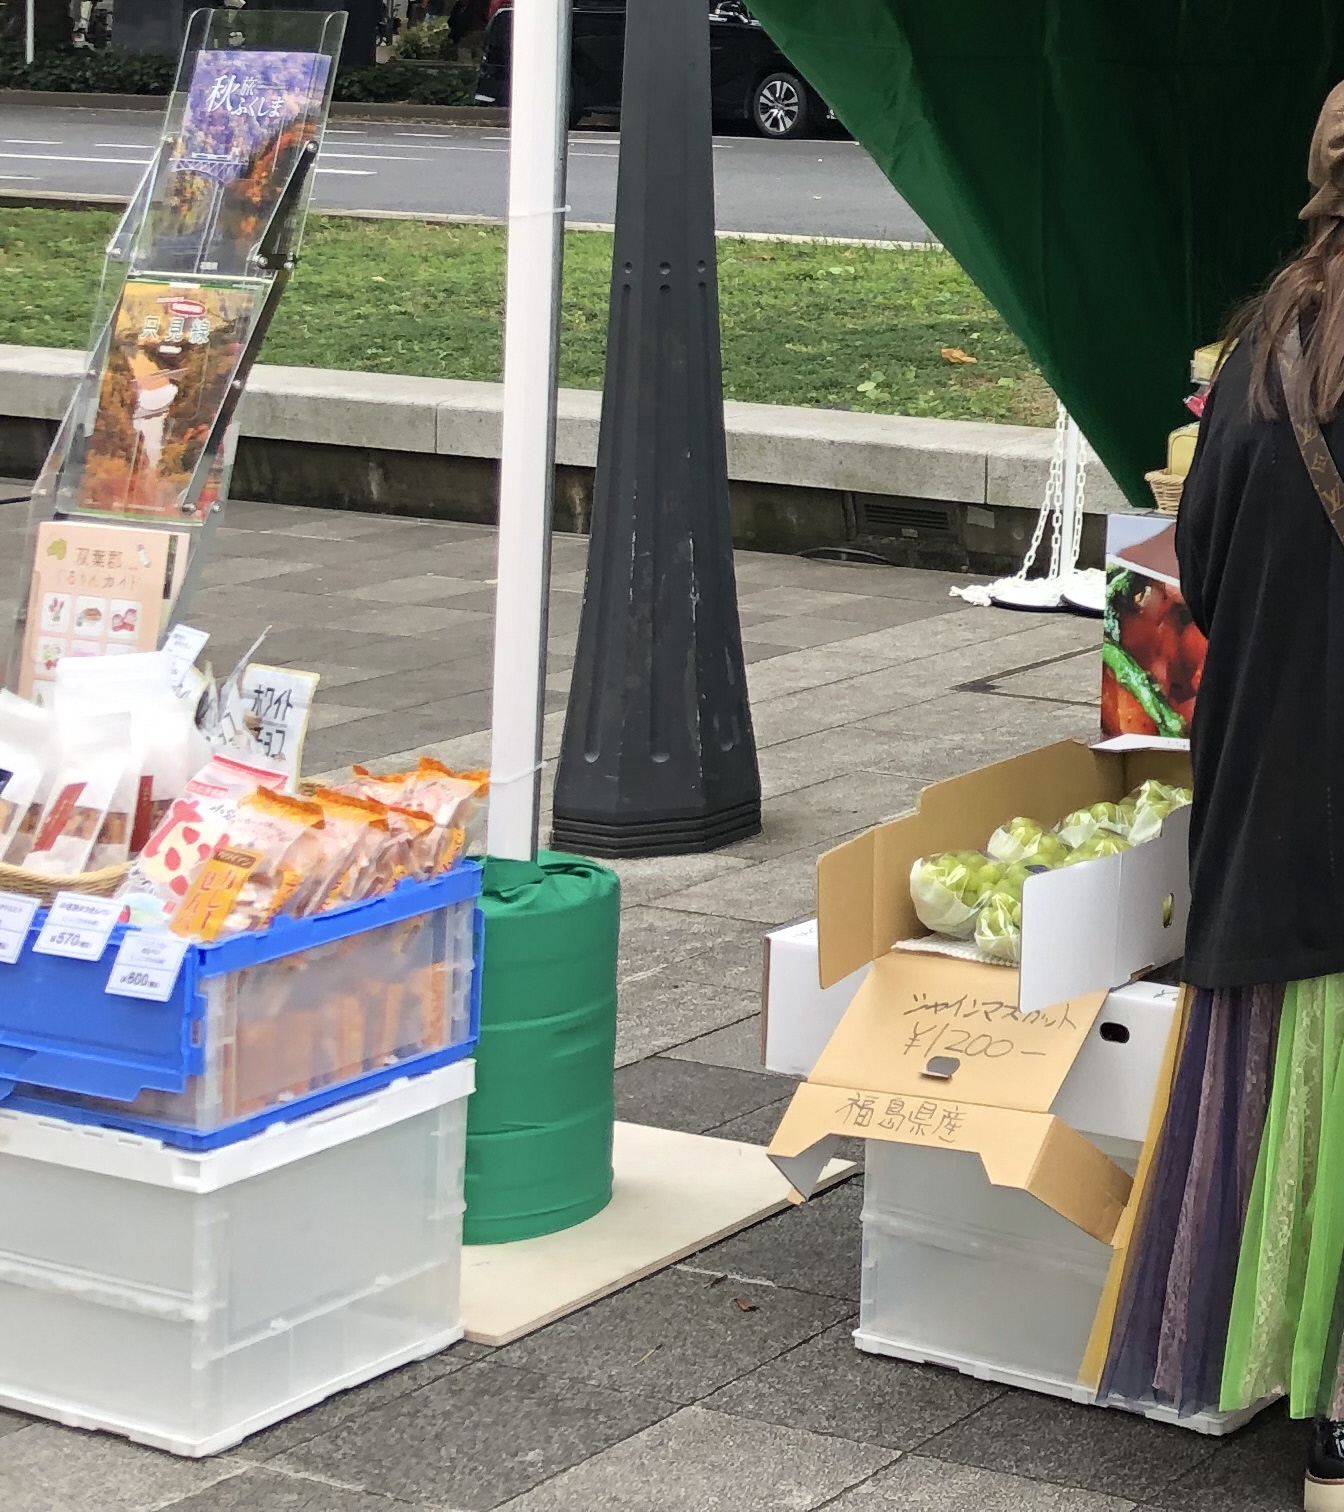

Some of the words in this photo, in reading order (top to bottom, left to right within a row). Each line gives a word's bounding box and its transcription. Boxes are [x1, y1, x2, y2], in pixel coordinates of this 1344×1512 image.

[232, 96, 284, 118] ふくしま
[140, 315, 211, 345] 只見線
[902, 992, 1079, 1032] シャインマスカット
[834, 1092, 965, 1144] 福島県産
